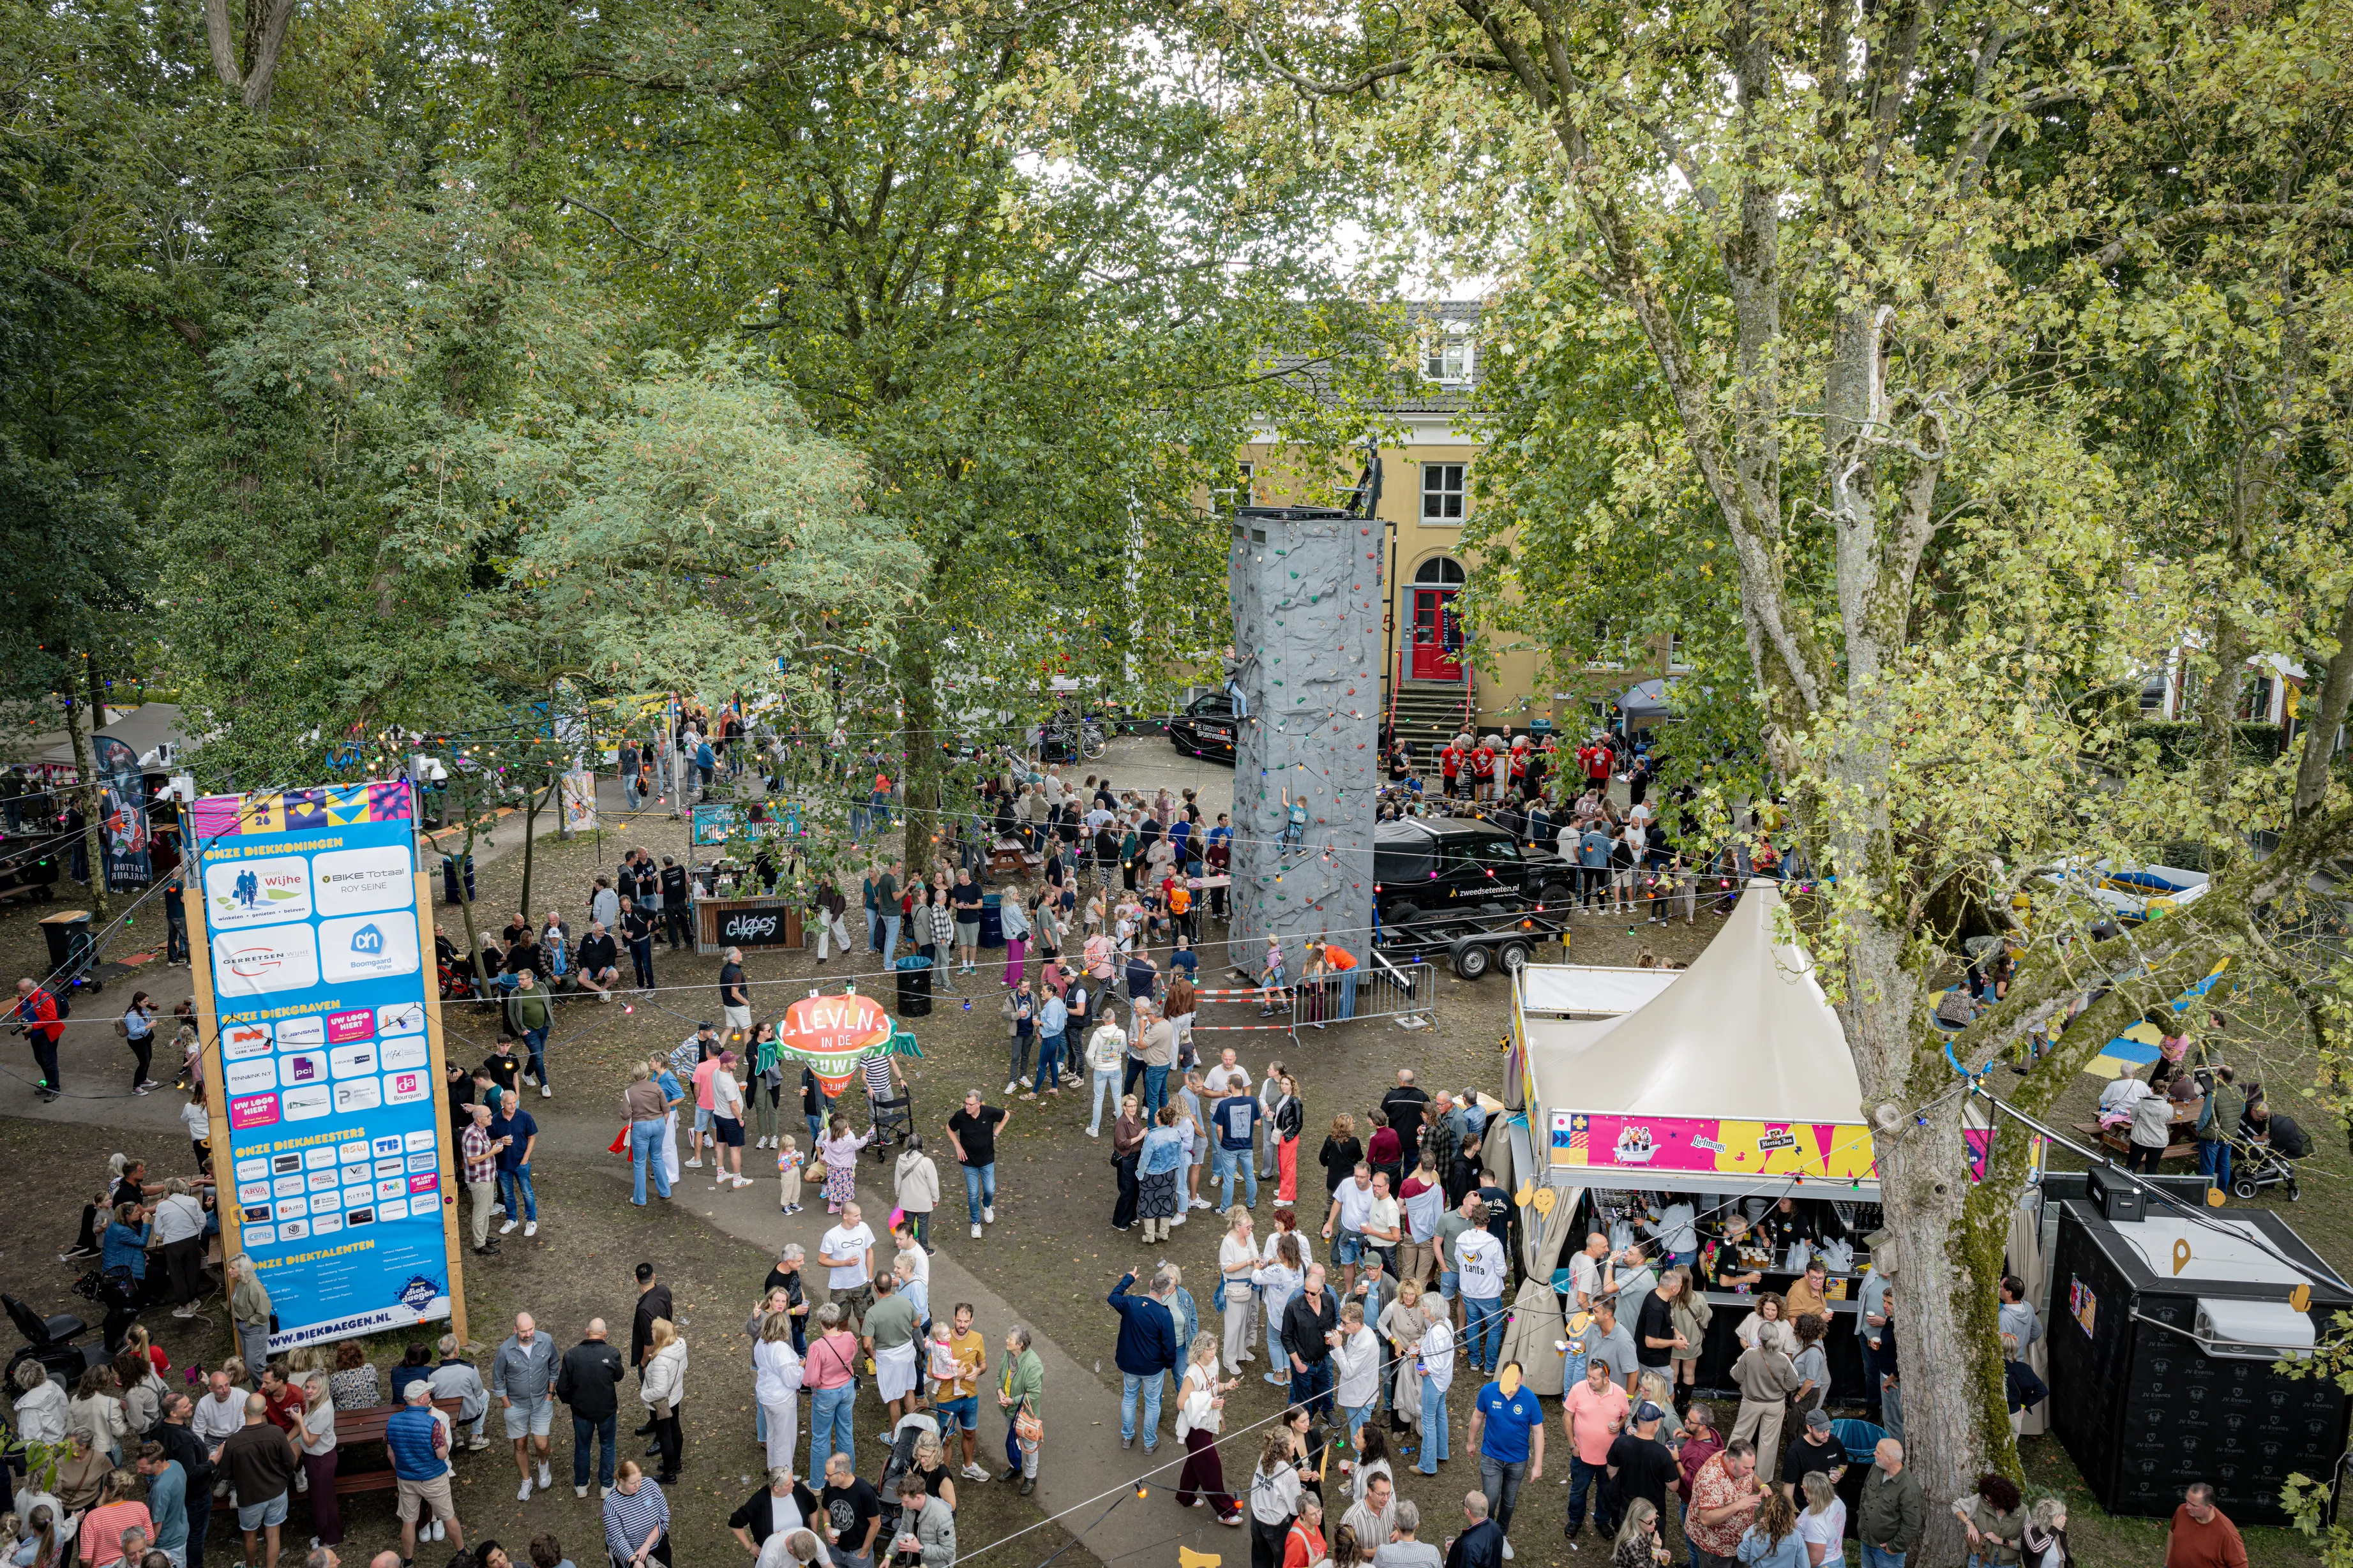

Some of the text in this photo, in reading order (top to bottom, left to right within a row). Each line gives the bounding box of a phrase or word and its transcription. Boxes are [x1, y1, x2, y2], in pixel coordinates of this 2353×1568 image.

[1382, 614, 1396, 633] 5
[1203, 724, 1226, 735] GROOTS
[1197, 731, 1231, 742] SPORTVOEDING
[255, 816, 271, 826] 26
[204, 837, 343, 861] ONZE DIEKKONINGEN
[258, 870, 283, 878] gastvrij
[333, 868, 404, 882] BIKE Totaal
[265, 876, 301, 886] Wijhe
[341, 882, 387, 893] ROY SEINE
[1459, 883, 1519, 897] zweedsetenten.nl
[223, 953, 284, 965] GERRETSEN
[350, 957, 392, 968] Boomgaard
[221, 999, 340, 1024] ONZE DIEKGRAVEN
[331, 1012, 370, 1025] UW LOGO
[340, 1020, 363, 1031] HIER?
[821, 1034, 852, 1048] IN DE
[231, 1072, 260, 1082] PENN&INK
[296, 1066, 312, 1077] pci
[398, 1077, 415, 1091] da
[394, 1092, 422, 1101] Bourquin
[234, 1096, 274, 1110] UW LOGO
[244, 1105, 267, 1116] HIER?
[235, 1127, 365, 1158] ONZE DIEKMEESTERS
[376, 1139, 399, 1153] TB
[1692, 1135, 1726, 1153] Liefmans
[1761, 1139, 1781, 1149] Hertog
[243, 1186, 267, 1198] ARVA
[249, 1231, 272, 1240] cents
[285, 1239, 375, 1266] DIEKTALENTEN
[401, 1289, 435, 1303] daegen
[406, 1285, 426, 1296] diek
[268, 1312, 392, 1348] WW.DIEKDAEGEN.NL
